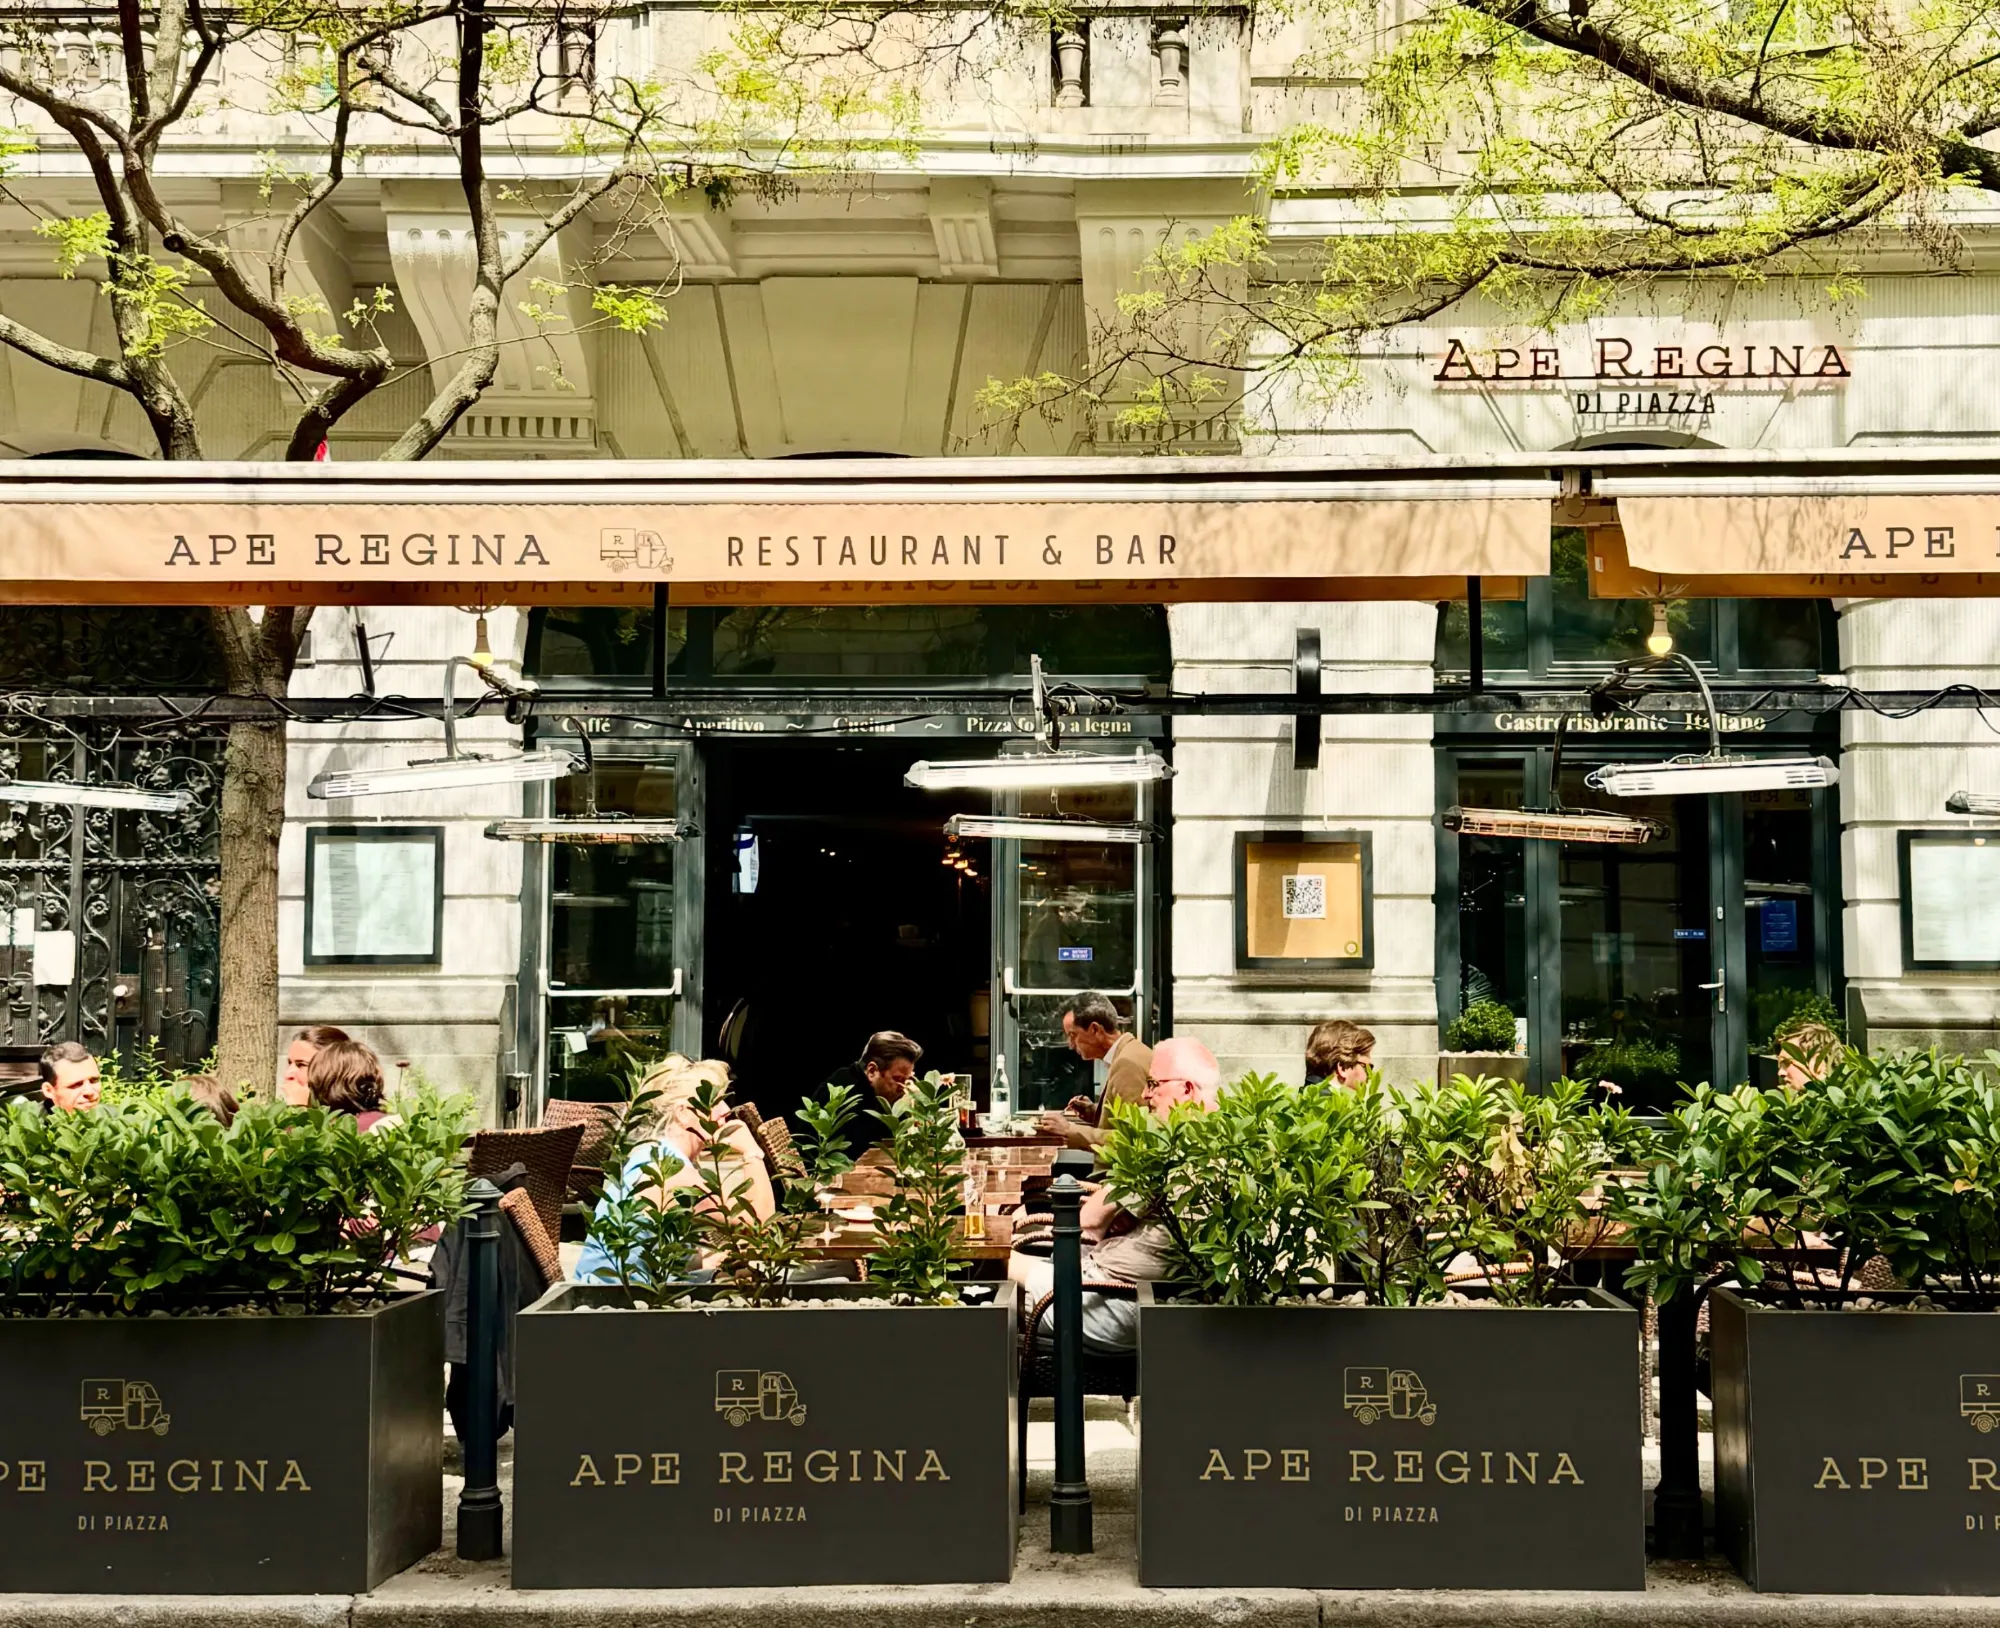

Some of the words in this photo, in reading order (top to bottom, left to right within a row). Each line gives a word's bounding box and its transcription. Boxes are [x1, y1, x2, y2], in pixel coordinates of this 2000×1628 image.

[1577, 393, 1601, 414] DI
[1619, 393, 1715, 414] PIAZZA
[613, 535, 624, 545] R
[1835, 526, 1955, 559] APE
[165, 534, 275, 566] APE
[315, 533, 550, 566] REGINA
[728, 535, 1010, 567] RESTAURANT
[1042, 534, 1063, 566] &
[1097, 534, 1177, 565] BAR
[832, 717, 896, 733] Cucina
[966, 717, 1012, 733] Pizza
[1018, 717, 1066, 733] fono
[1069, 723, 1080, 733] a
[1086, 717, 1132, 737] legna
[732, 1378, 746, 1391] R
[1360, 1376, 1374, 1389] R
[1976, 1383, 1991, 1396] R
[97, 1387, 110, 1400] R
[570, 1453, 680, 1486] APE
[719, 1449, 951, 1484] REGINA
[1199, 1448, 1310, 1482] APE
[1349, 1450, 1585, 1485] REGINA
[1813, 1457, 1929, 1490] APE
[84, 1459, 311, 1493] REGINA
[78, 1515, 95, 1531] DI
[106, 1515, 169, 1531] PIAZZA
[714, 1507, 731, 1523] DI
[742, 1506, 808, 1522] PIAZZA
[1345, 1506, 1362, 1522] DI
[1373, 1506, 1439, 1523] PIAZZA
[1965, 1514, 1984, 1530] DI
